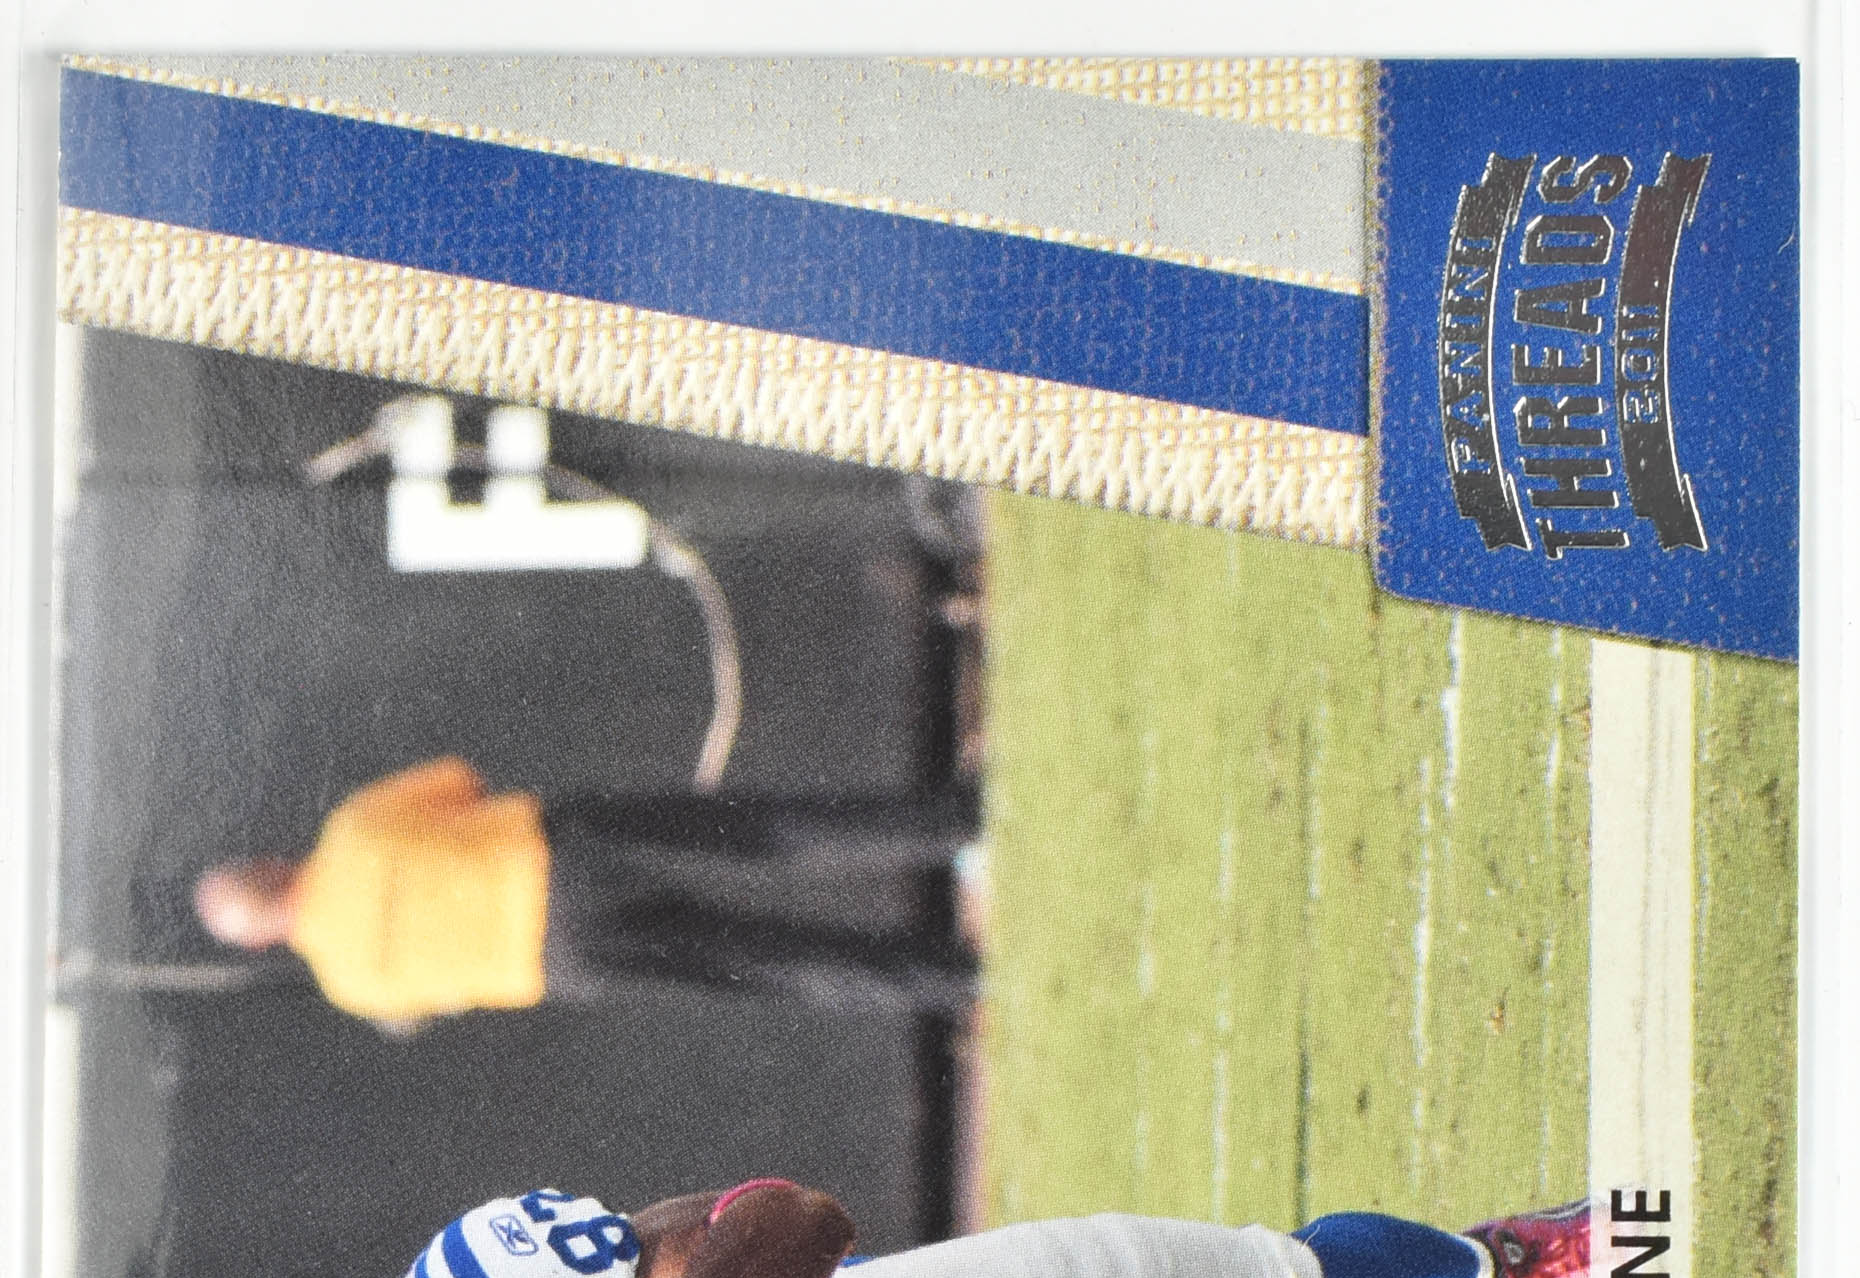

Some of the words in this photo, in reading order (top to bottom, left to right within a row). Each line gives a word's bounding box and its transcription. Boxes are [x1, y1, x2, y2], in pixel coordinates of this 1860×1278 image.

[1444, 236, 1495, 475] PANINI
[1511, 154, 1633, 561] THREADS
[1621, 303, 1661, 426] 2011
